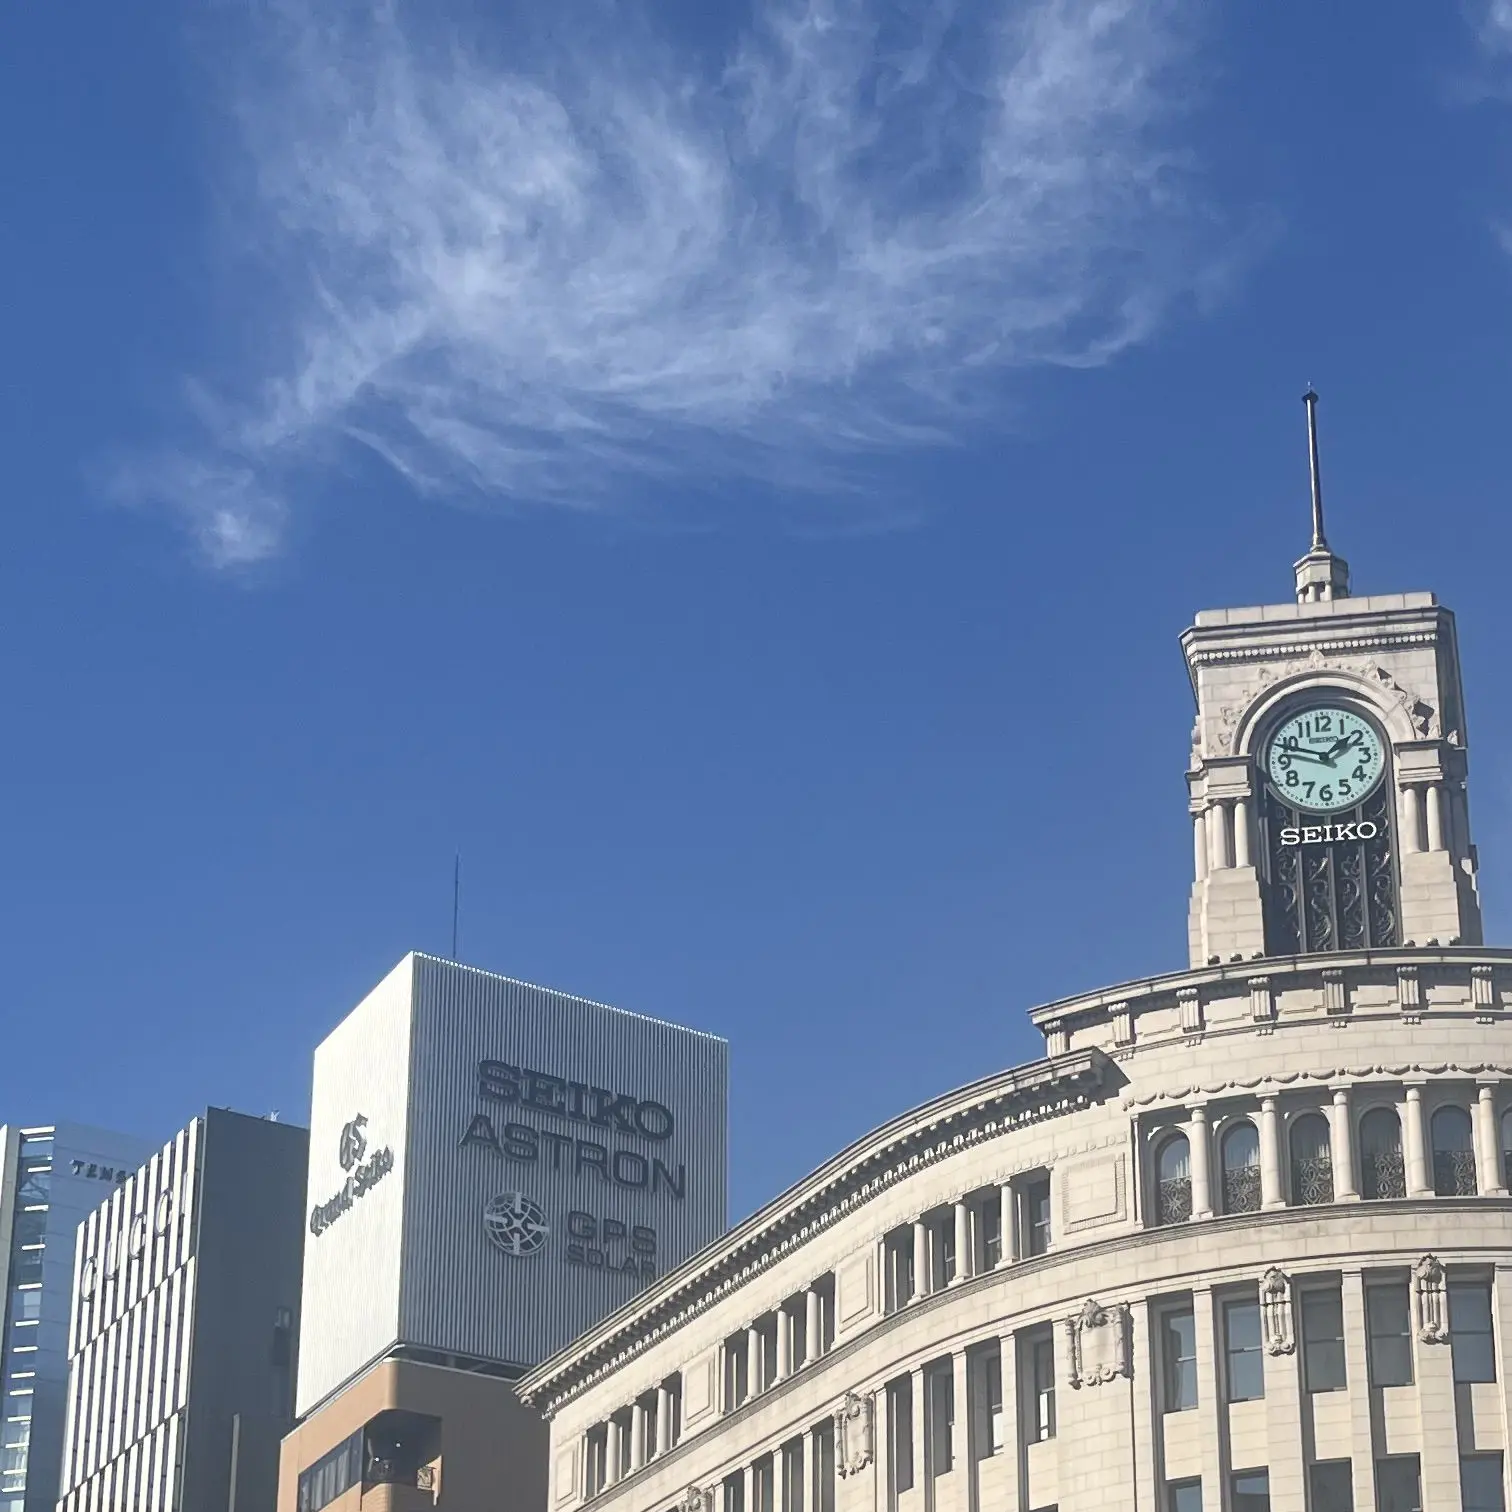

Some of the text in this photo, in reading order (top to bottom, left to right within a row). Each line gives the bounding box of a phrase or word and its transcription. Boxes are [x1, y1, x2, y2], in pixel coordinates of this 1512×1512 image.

[1298, 720, 1310, 738] 11
[1314, 715, 1331, 732] 12
[1350, 729, 1364, 746] 2
[1278, 753, 1291, 770] 9
[1358, 747, 1371, 764] 3
[1285, 770, 1299, 787] 8
[1352, 765, 1367, 781] 4
[1302, 781, 1315, 798] 7
[1319, 784, 1333, 801] 6
[1338, 779, 1351, 795] 5
[1280, 821, 1377, 846] SEIKO
[477, 1059, 675, 1141] SEIKO
[457, 1114, 686, 1201] ASTRON
[69, 1159, 136, 1184] TENS
[567, 1210, 656, 1254] GPS
[567, 1243, 656, 1279] SOLAR
